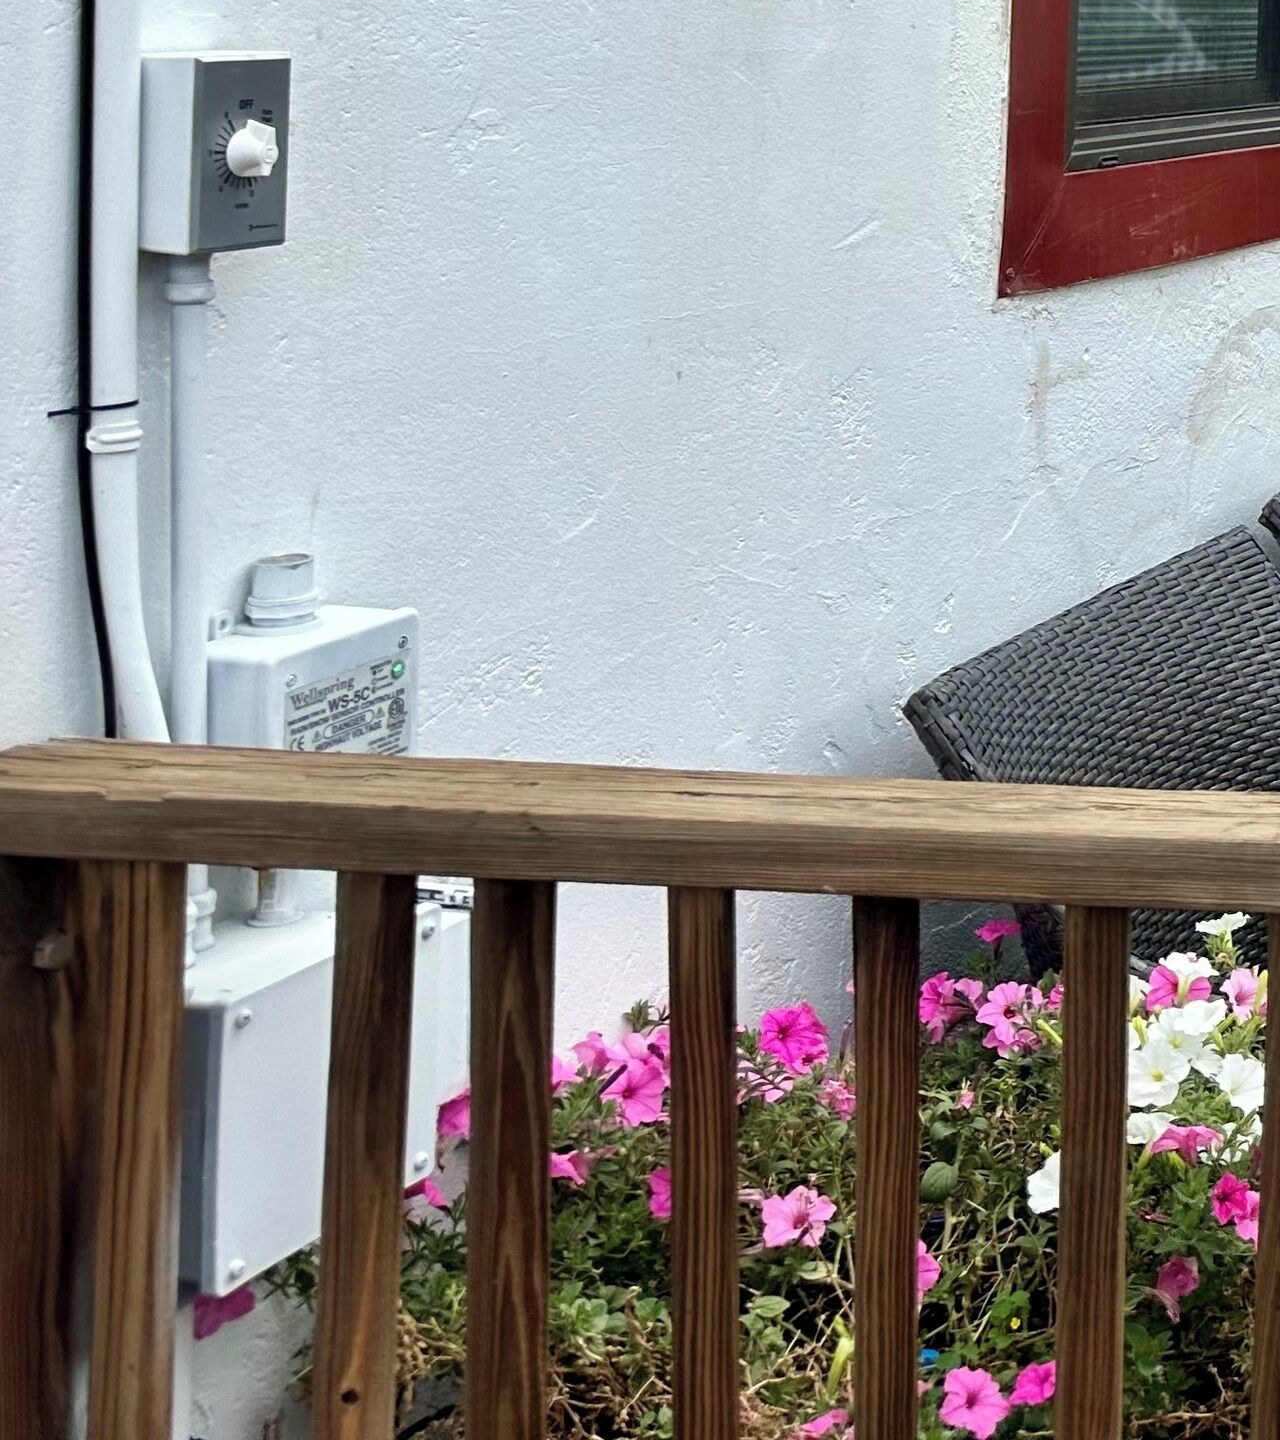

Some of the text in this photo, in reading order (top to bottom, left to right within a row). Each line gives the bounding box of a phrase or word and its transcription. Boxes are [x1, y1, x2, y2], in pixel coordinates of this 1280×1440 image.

[239, 99, 255, 110] OFF
[290, 677, 356, 708] Wellspring
[328, 686, 370, 712] WS-5C
[331, 714, 366, 734] DANGER
[351, 720, 383, 738] VOLTAGE
